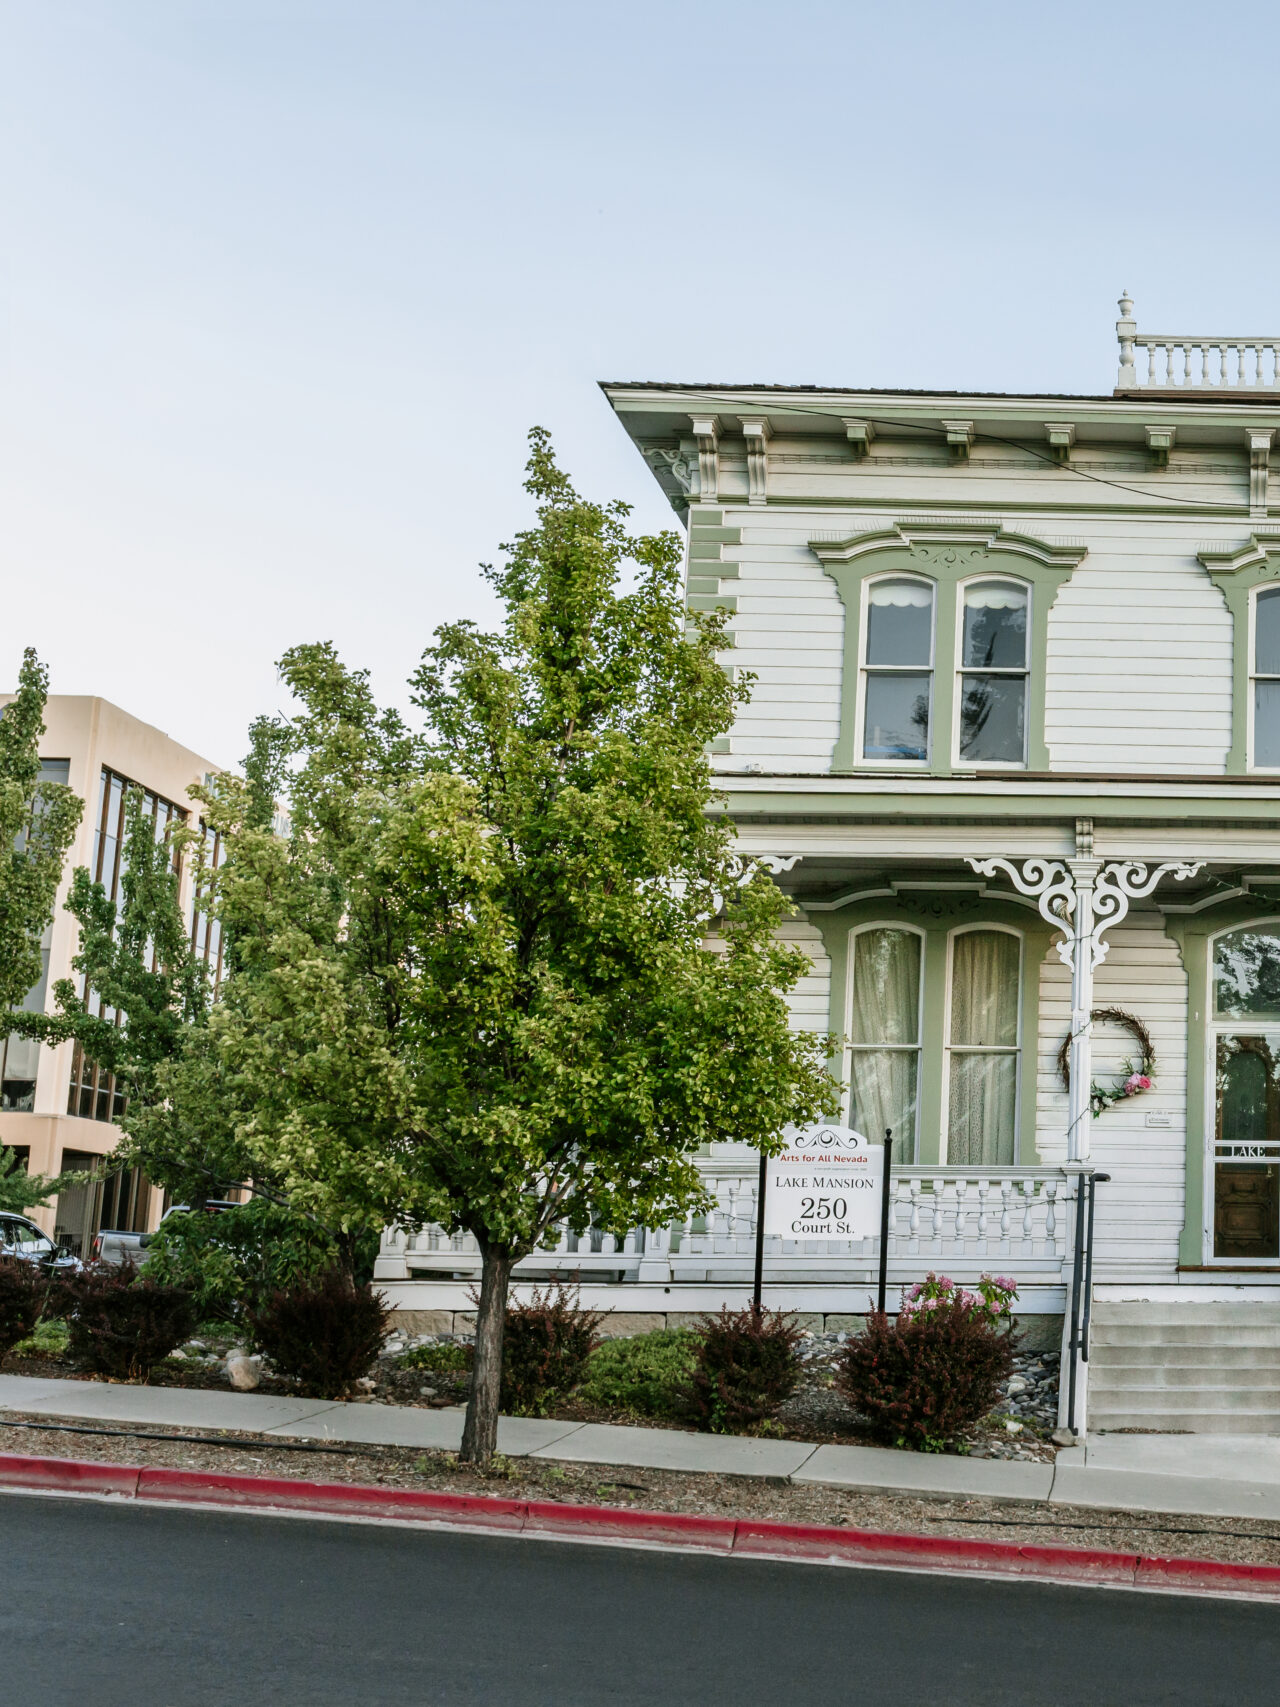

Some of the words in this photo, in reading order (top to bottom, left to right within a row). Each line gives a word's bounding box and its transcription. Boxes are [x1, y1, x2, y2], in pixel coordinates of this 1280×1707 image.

[1231, 1146, 1266, 1157] LAKE
[780, 1154, 799, 1162] Arts
[802, 1154, 816, 1162] for
[818, 1154, 831, 1162] All
[833, 1155, 868, 1163] Nevada
[776, 1176, 808, 1188] LAKE
[812, 1177, 874, 1189] MANSION
[800, 1197, 847, 1220] 250
[791, 1221, 832, 1234] Court
[836, 1221, 855, 1234] St.
